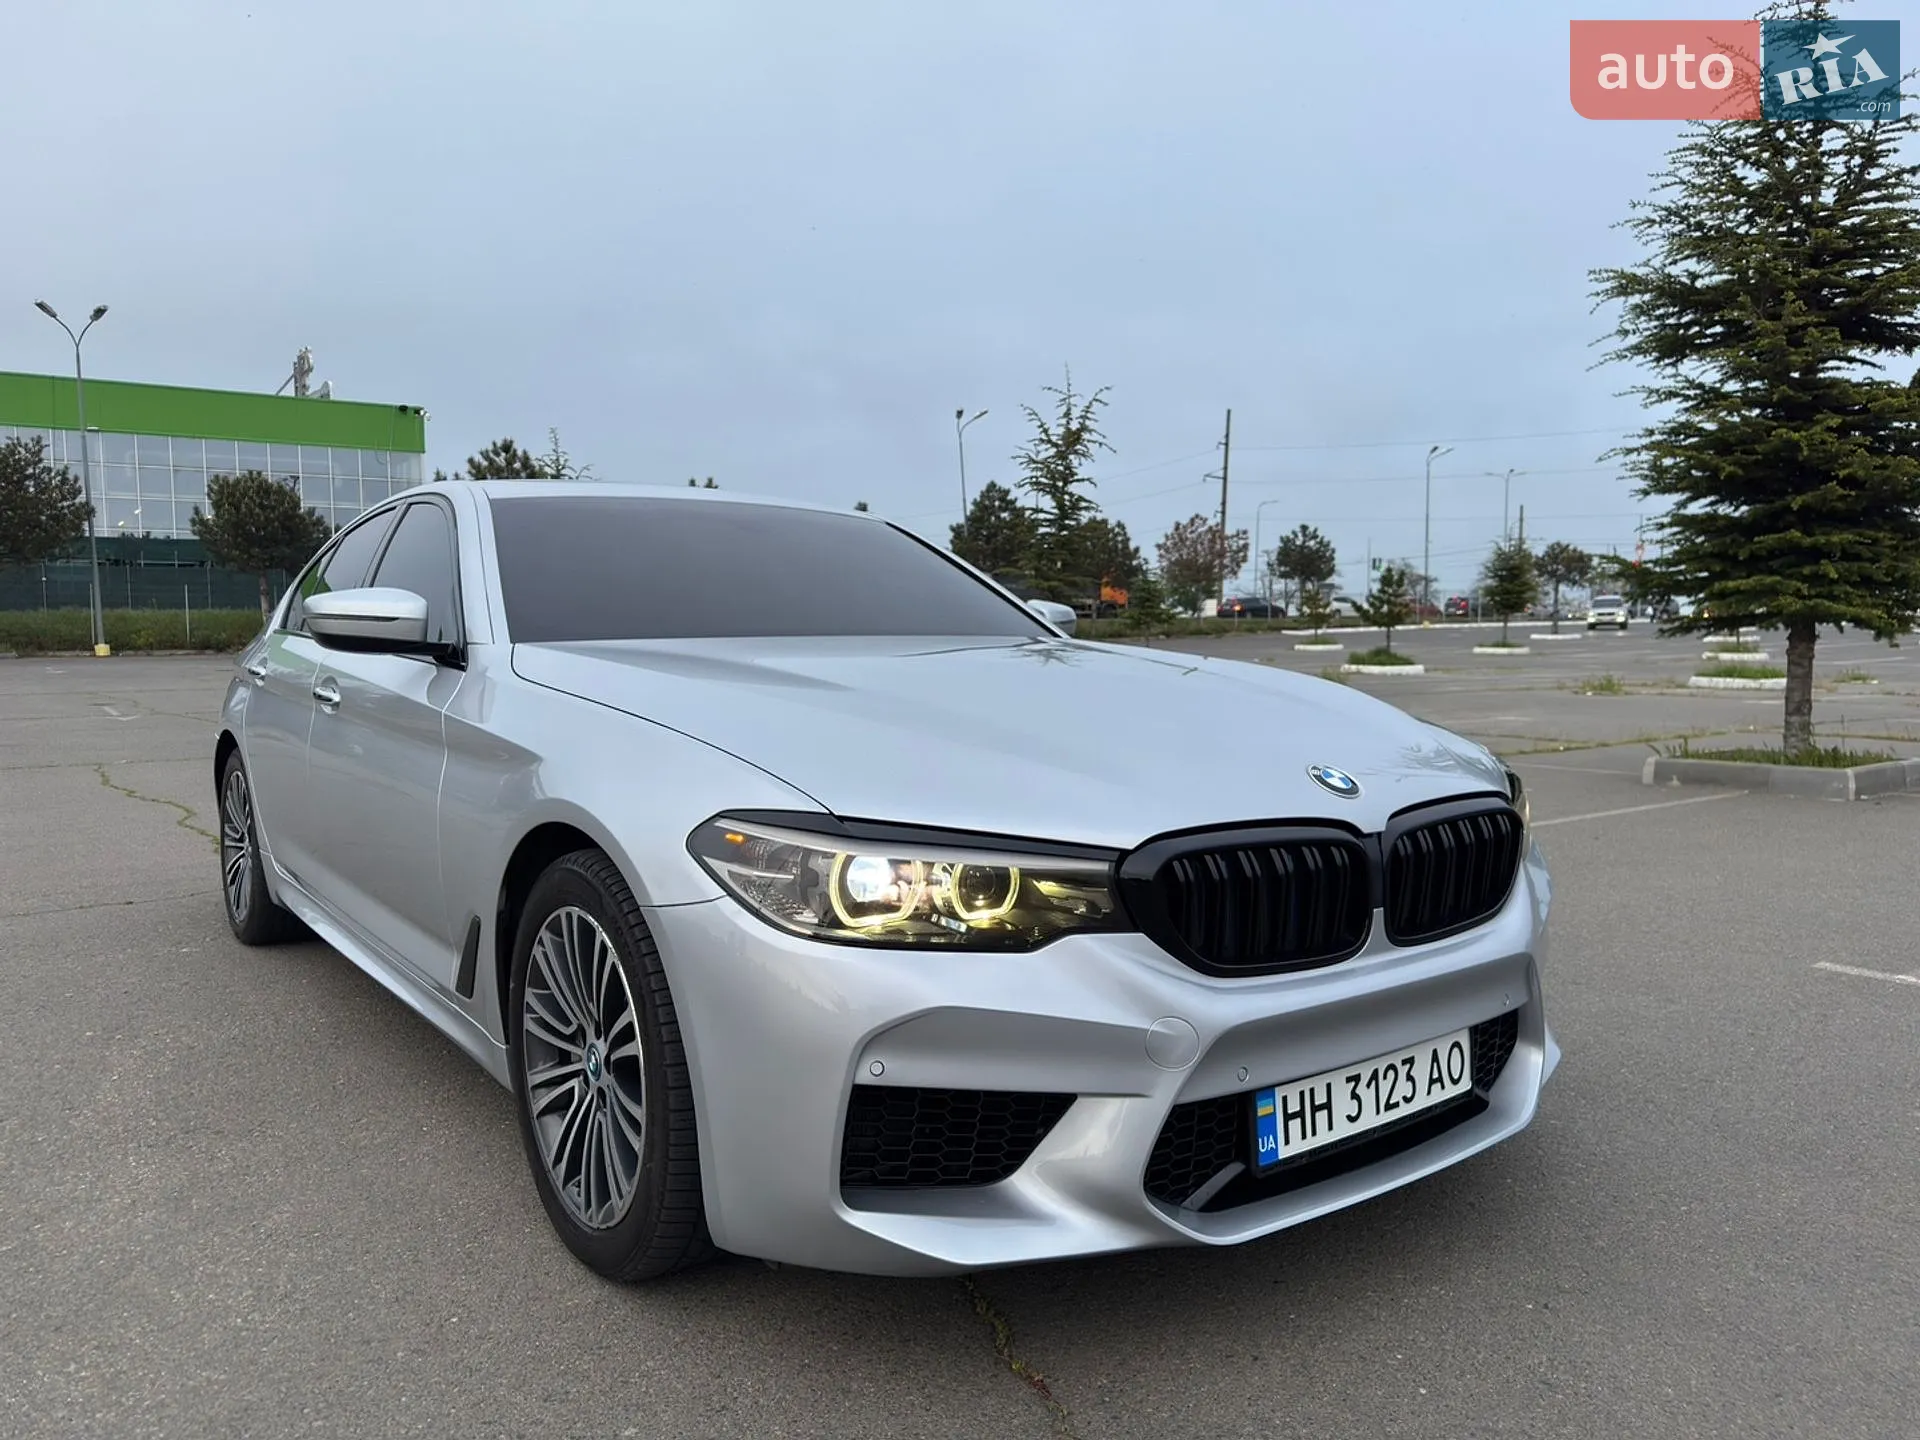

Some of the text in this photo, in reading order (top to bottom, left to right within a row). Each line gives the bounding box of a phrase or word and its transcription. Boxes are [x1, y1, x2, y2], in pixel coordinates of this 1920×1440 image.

[1281, 1040, 1465, 1146] HH 3123 AO
[1258, 1135, 1276, 1152] UA
